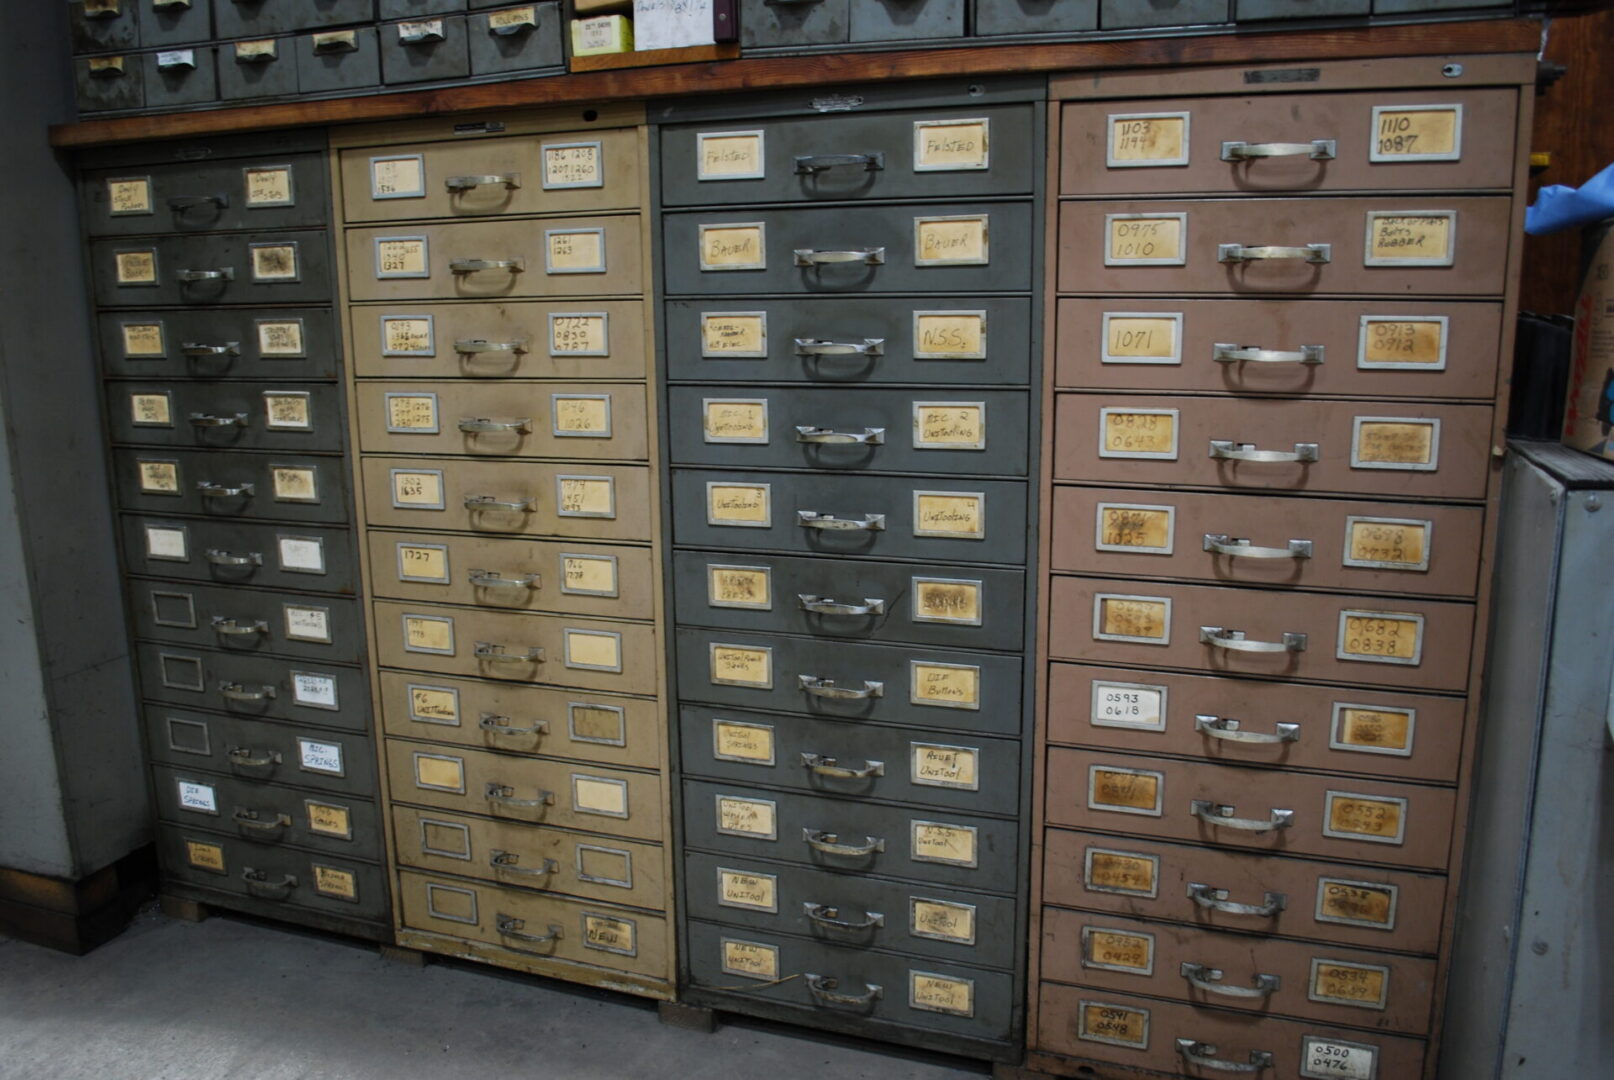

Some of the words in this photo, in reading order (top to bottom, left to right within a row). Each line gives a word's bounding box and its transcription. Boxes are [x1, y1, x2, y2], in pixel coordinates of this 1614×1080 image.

[1121, 121, 1152, 136] 1103
[1381, 117, 1411, 135] 1110
[1378, 135, 1419, 154] 1087
[1117, 222, 1166, 238] 0975
[1117, 242, 1155, 256] 1010
[1115, 330, 1153, 349] 1071
[1349, 638, 1397, 655] 0838
[1106, 693, 1140, 704] 0593
[1106, 705, 1140, 716] 0618
[589, 929, 619, 944] NEW
[1315, 1045, 1351, 1058] 0500
[1313, 1058, 1349, 1070] 0476
